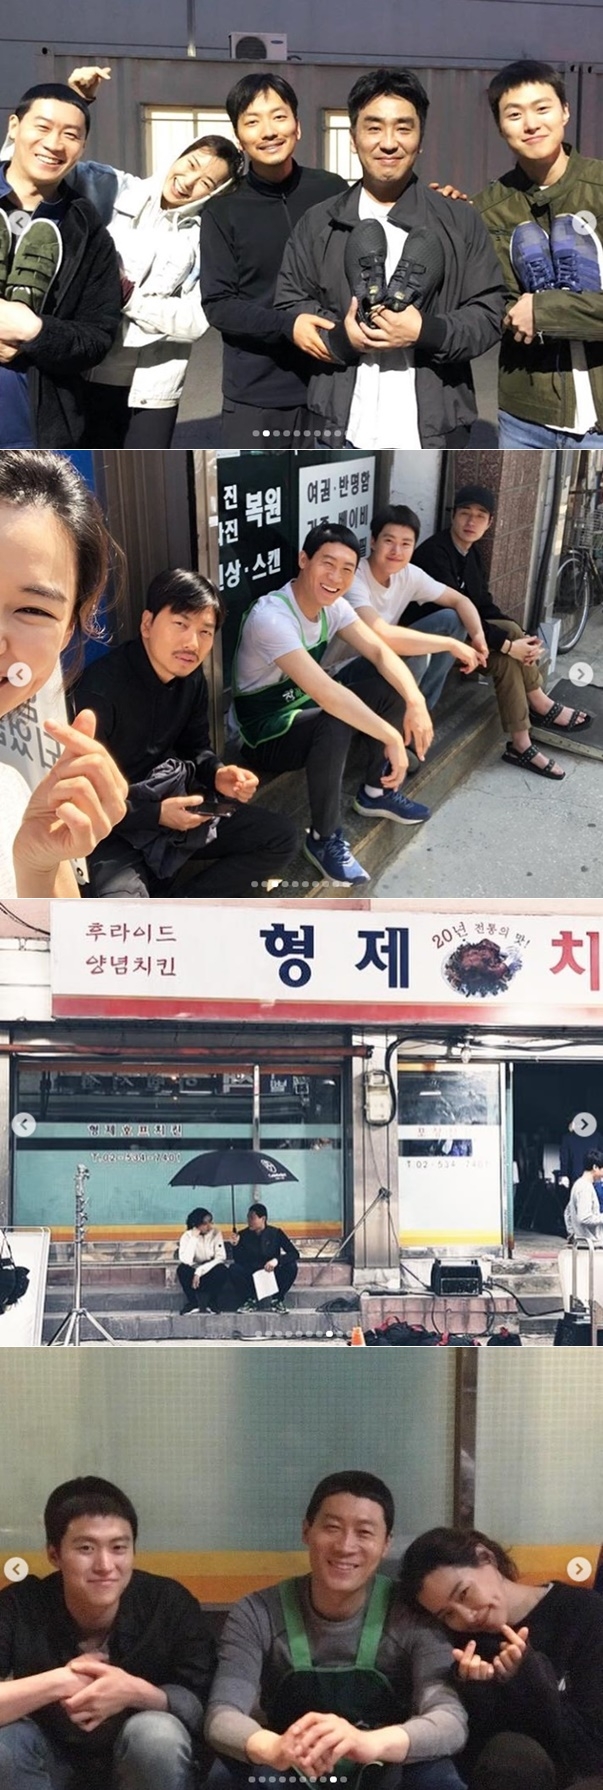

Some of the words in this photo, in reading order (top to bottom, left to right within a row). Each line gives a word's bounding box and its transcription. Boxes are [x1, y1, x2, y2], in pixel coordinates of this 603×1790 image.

[245, 486, 281, 528] 복원
[85, 922, 177, 944] 후라이드
[431, 921, 468, 949] 20년
[475, 922, 510, 938] 전통의
[514, 932, 531, 949] 맛!
[85, 954, 177, 976] 양념치킨
[549, 930, 600, 991] 치
